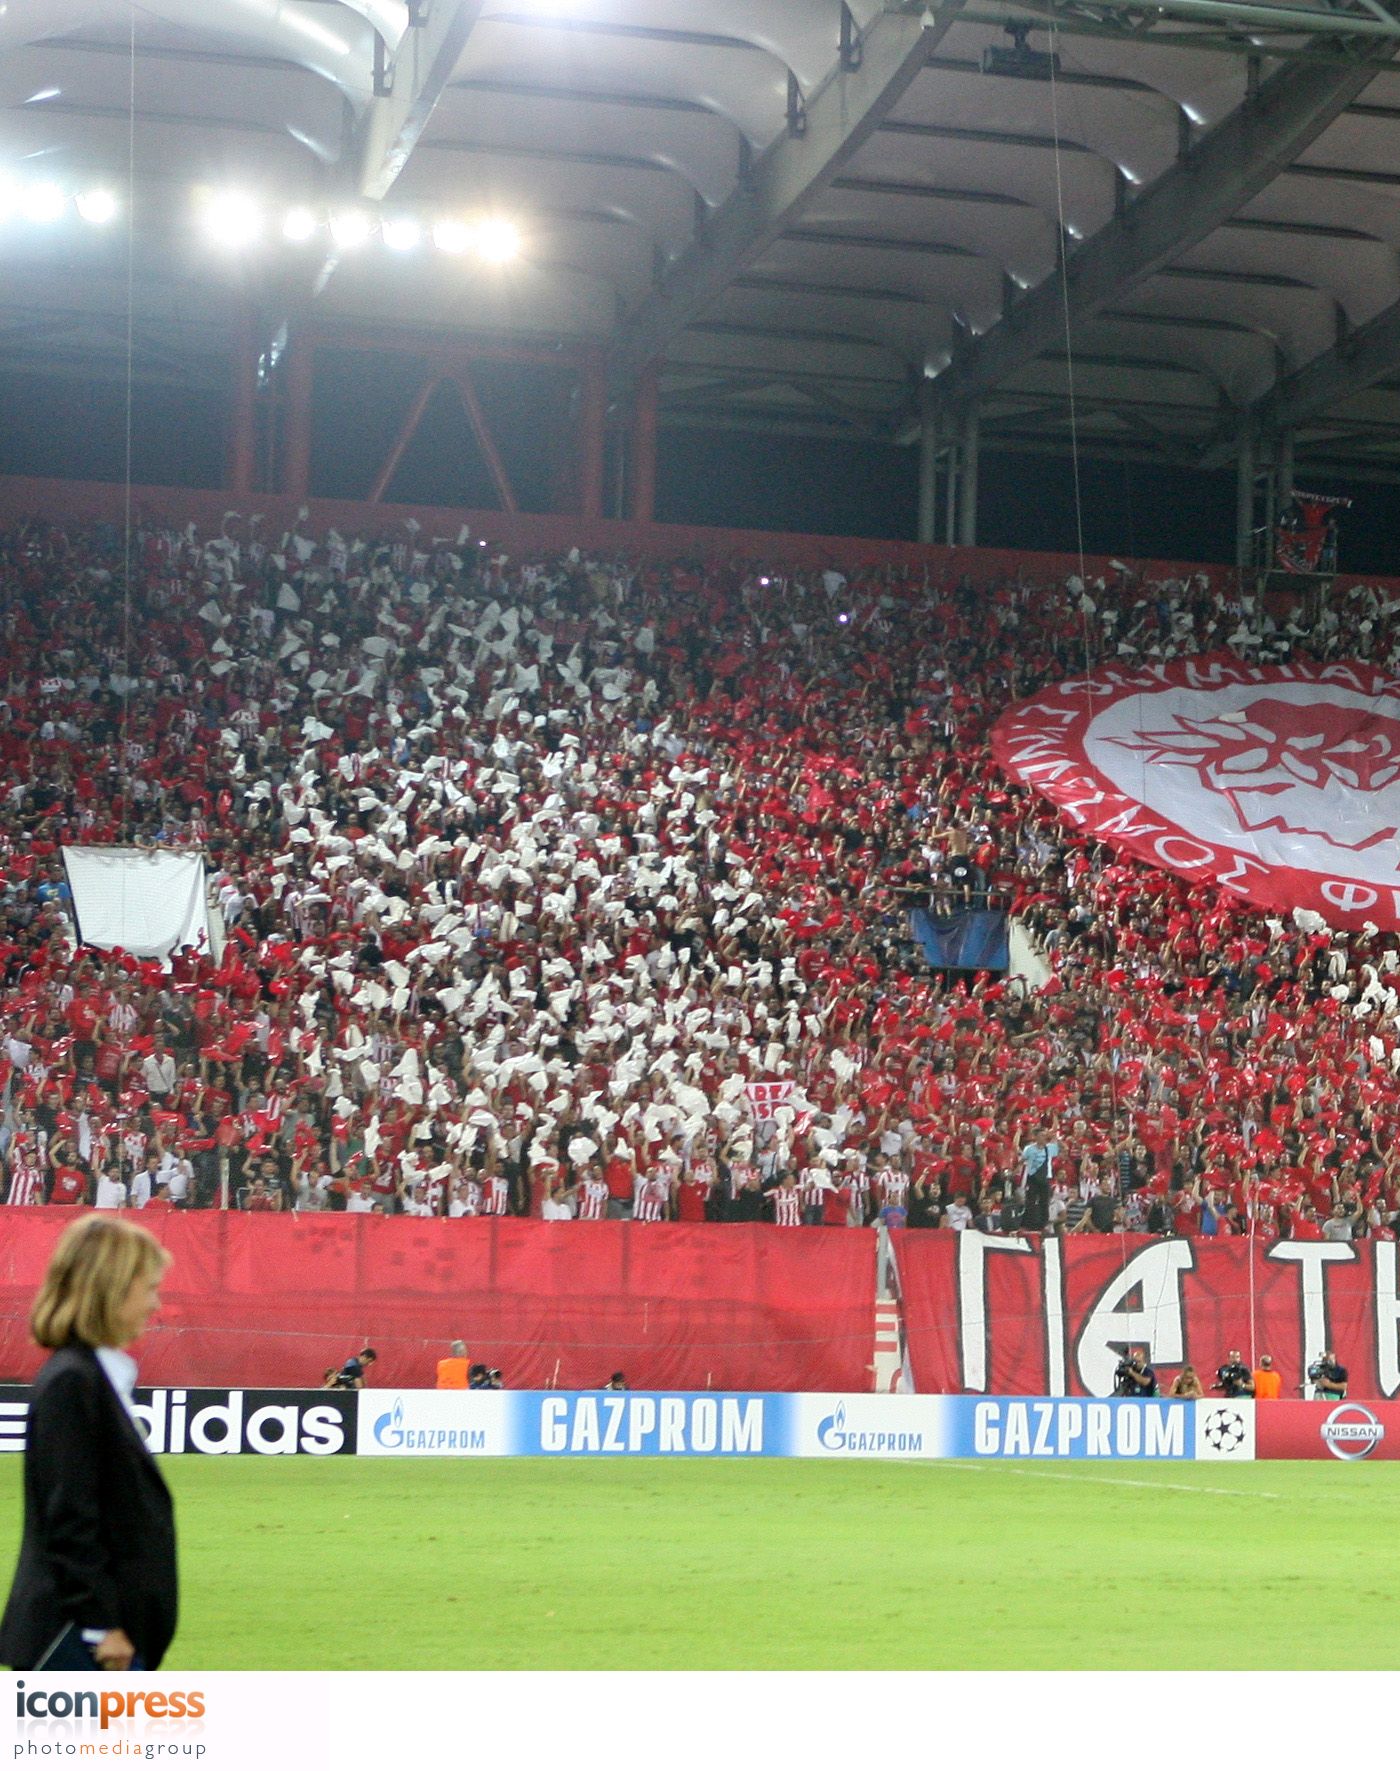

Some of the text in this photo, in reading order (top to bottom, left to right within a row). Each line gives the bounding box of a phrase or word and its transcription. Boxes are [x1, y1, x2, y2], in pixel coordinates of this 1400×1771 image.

[958, 1229, 1196, 1398] ΓΙΑ
[130, 1390, 345, 1455] didas
[403, 1427, 486, 1450] GAZPROM
[541, 1397, 763, 1453] GAZPROM
[847, 1431, 923, 1452] GAZPROM
[975, 1402, 1184, 1457] GAZPROM
[1326, 1425, 1378, 1437] NISSAN
